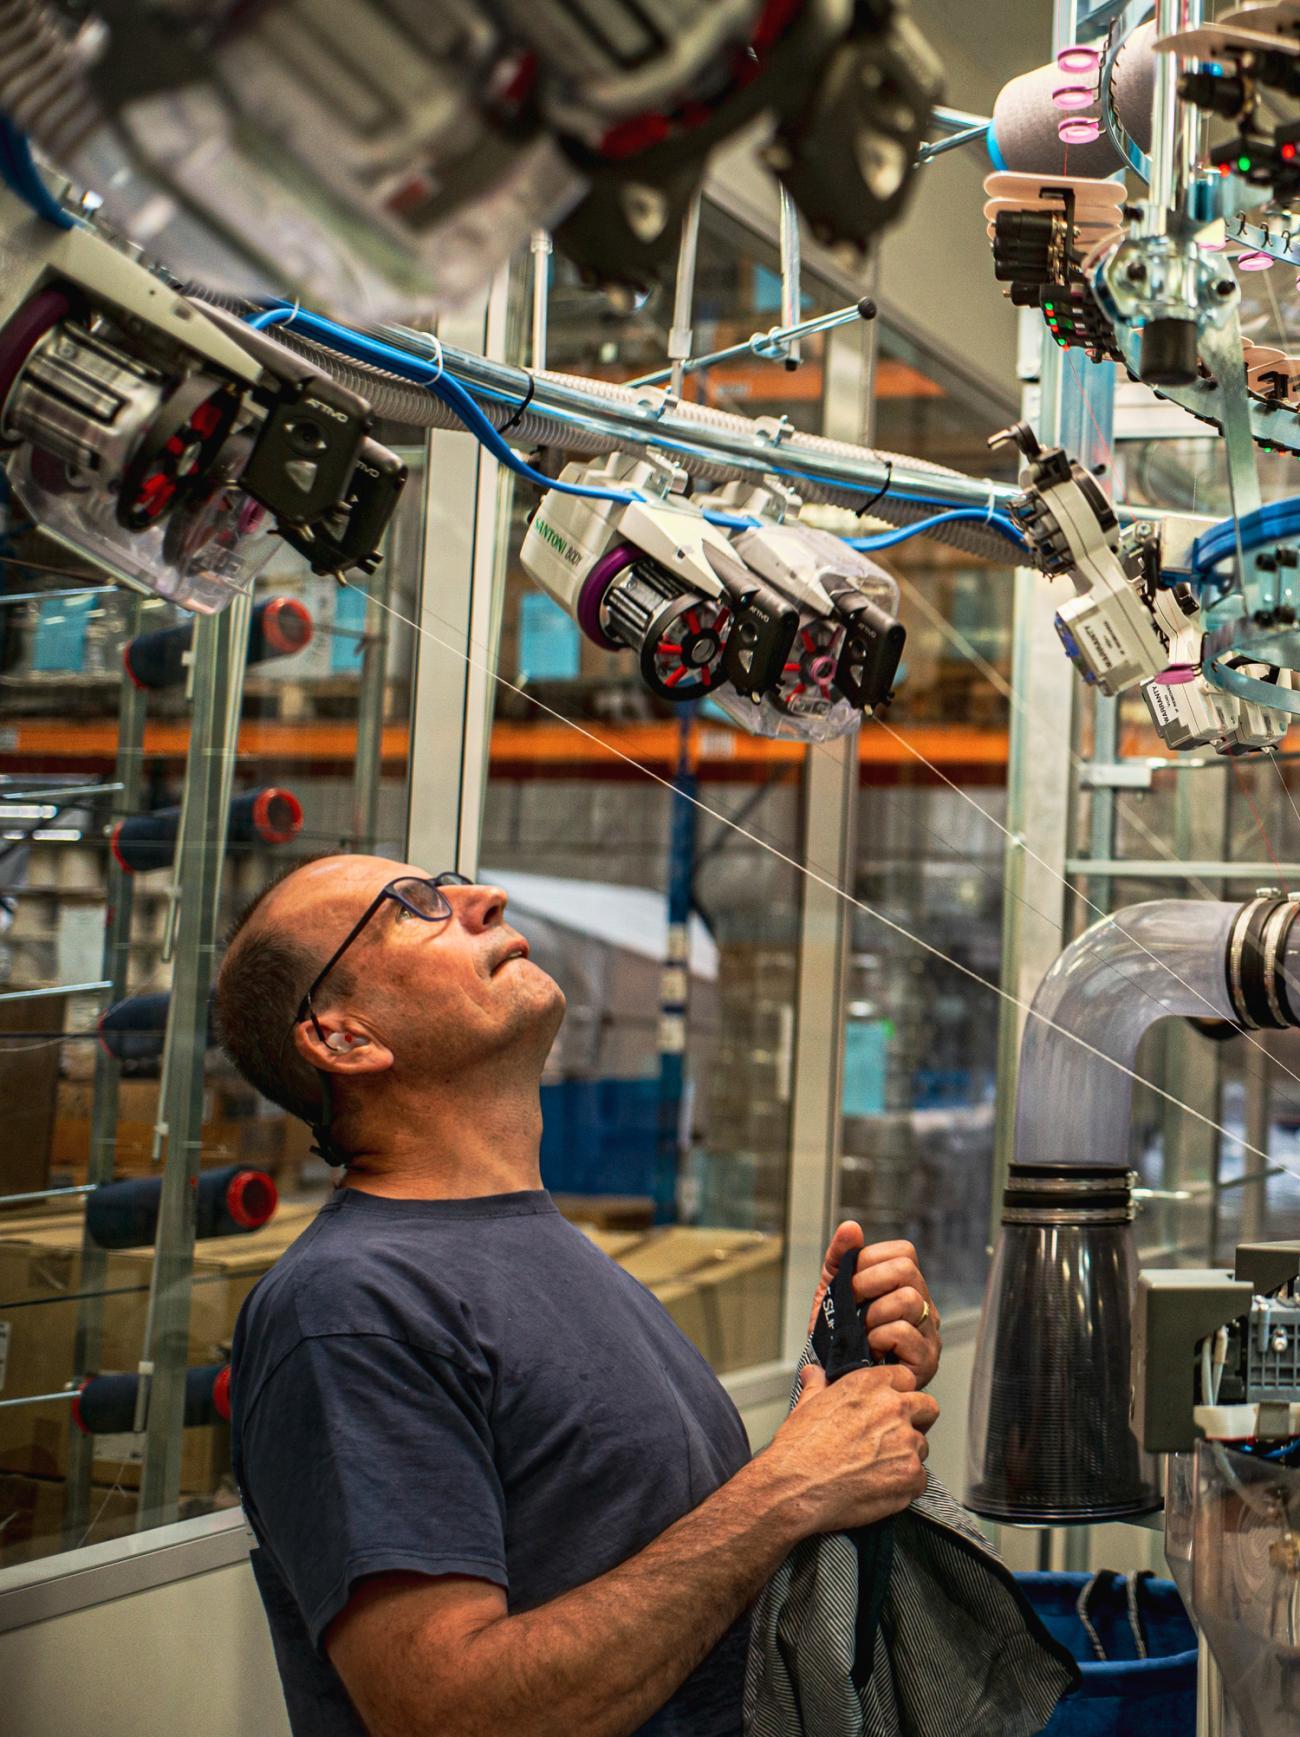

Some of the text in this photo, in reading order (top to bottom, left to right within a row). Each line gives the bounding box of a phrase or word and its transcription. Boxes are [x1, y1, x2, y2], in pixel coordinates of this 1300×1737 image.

[535, 516, 567, 555] SANTONI
[1083, 625, 1113, 668] WARRANTY
[1152, 685, 1170, 724] WARRANTY
